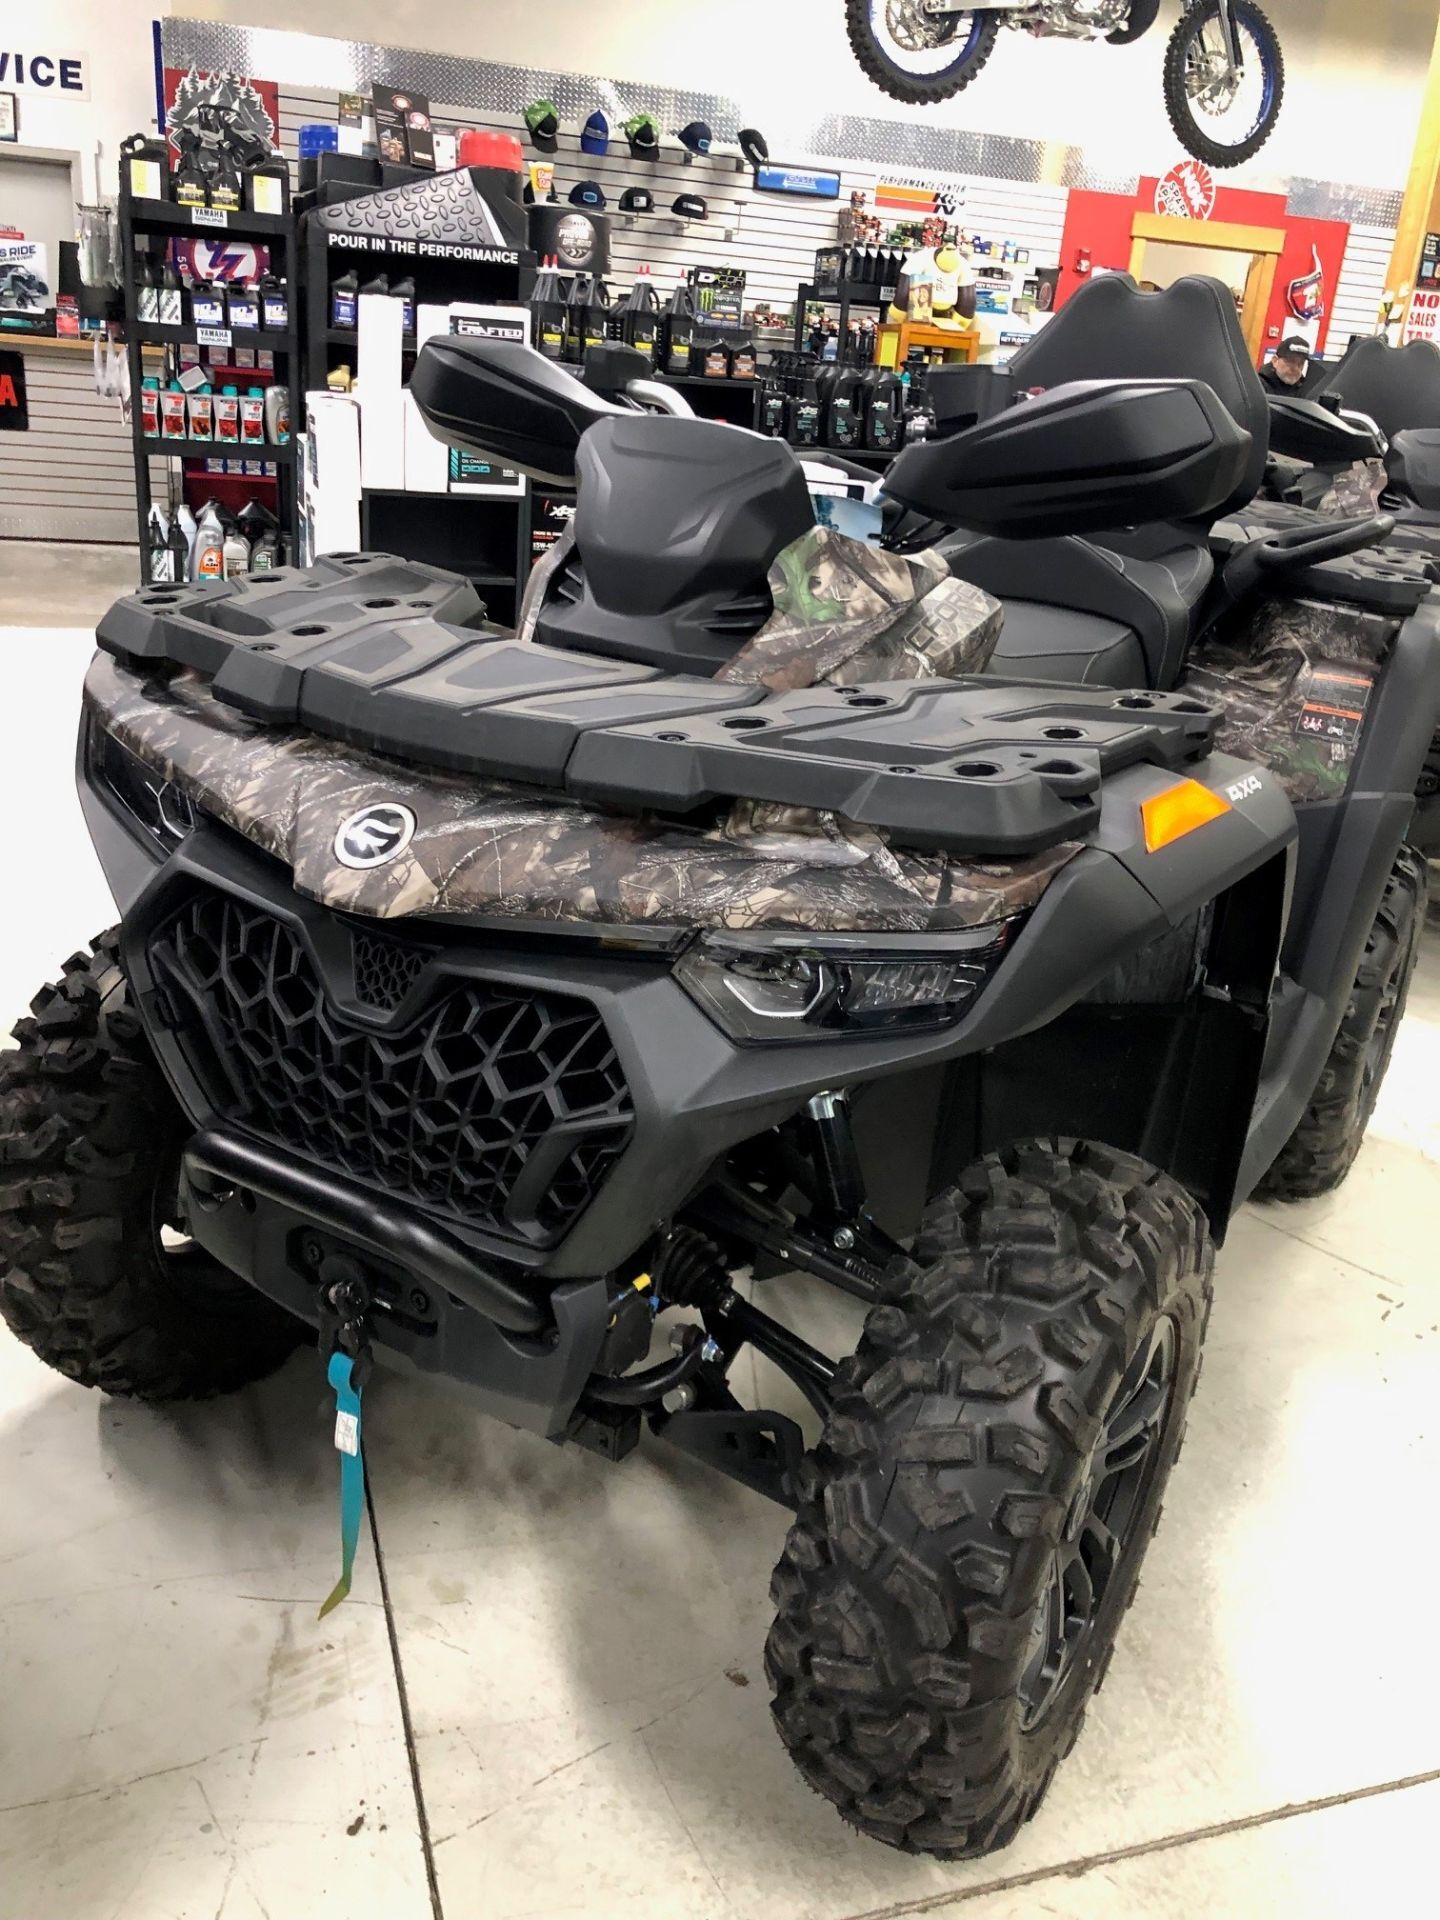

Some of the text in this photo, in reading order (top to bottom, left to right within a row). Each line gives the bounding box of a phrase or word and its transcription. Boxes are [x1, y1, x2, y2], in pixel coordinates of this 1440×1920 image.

[194, 208, 224, 219] YAMAHA
[9, 245, 36, 256] RIDE
[328, 233, 519, 265] POUR IN THE PERFORMANCE
[1413, 293, 1440, 308] NO
[1409, 312, 1436, 327] SALES
[200, 330, 228, 338] YAMAHA
[1226, 776, 1262, 801] 4X4
